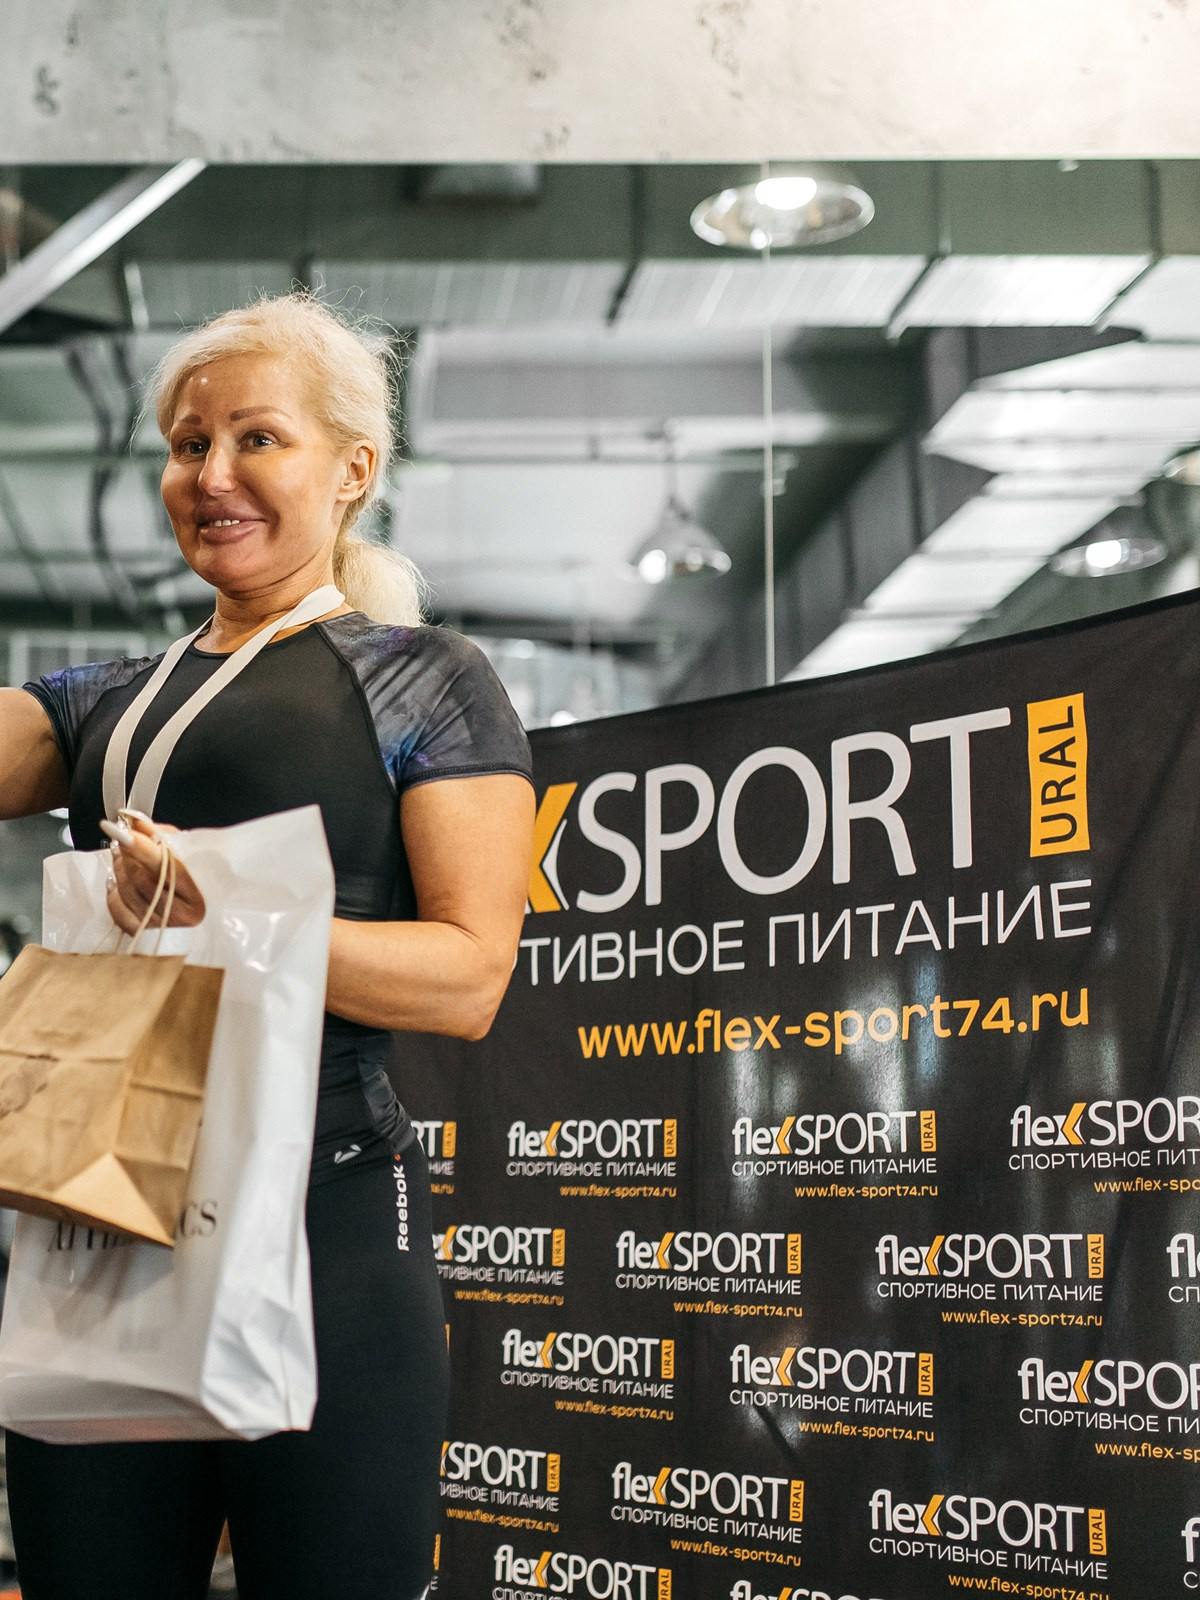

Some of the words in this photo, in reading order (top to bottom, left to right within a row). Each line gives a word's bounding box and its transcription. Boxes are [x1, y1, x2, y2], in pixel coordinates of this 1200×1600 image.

[1039, 704, 1078, 845] URAL
[512, 920, 745, 985] ТИВНОЕ
[768, 879, 1092, 966] ПИТАНИЕ
[578, 988, 1090, 1059] www.flex-sport74.ru
[506, 1161, 602, 1177] СПОРТИВНОЕ
[606, 1161, 676, 1177] ПИТАНИЕ
[732, 1159, 844, 1177] СПОРТИВНОЕ
[850, 1157, 937, 1175] ПИТАНИЕ
[1008, 1150, 1150, 1171] СПОРТИВНОЕ
[795, 1184, 938, 1199] www.flex-sport74.ru
[393, 1164, 410, 1252] Reebok
[498, 1267, 564, 1286] ПИТАНИЕ
[615, 1273, 720, 1293] СПОРТИВНОЕ
[724, 1277, 801, 1295] ПИТАНИЕ
[877, 1282, 996, 1300] СПОРТИВНОЕ
[1003, 1284, 1103, 1302] ПИТАНИЕ
[673, 1300, 803, 1318] www.flex-sport74.ru
[942, 1310, 1103, 1327] www.flex-sport74.ru
[500, 1370, 599, 1393] СПОРТИВНОЕ
[602, 1378, 674, 1399] ПИТАНИЕ
[729, 1389, 850, 1413] СПОРТИВНОЕ
[855, 1397, 934, 1418] ПИТАНИЕ
[800, 1421, 934, 1442] www.flex-sport74.ru
[1019, 1408, 1160, 1432] СПОРТИВНОЕ
[490, 1489, 560, 1513] ПИТАНИЕ
[611, 1505, 719, 1534] СПОРТИВНОЕ
[724, 1519, 802, 1544] ПИТАНИЕ
[670, 1538, 802, 1567] www.flex-sport74.ru
[869, 1538, 1008, 1568] СПОРТИВНОЕ
[1015, 1553, 1109, 1580] ПИТАНИЕ
